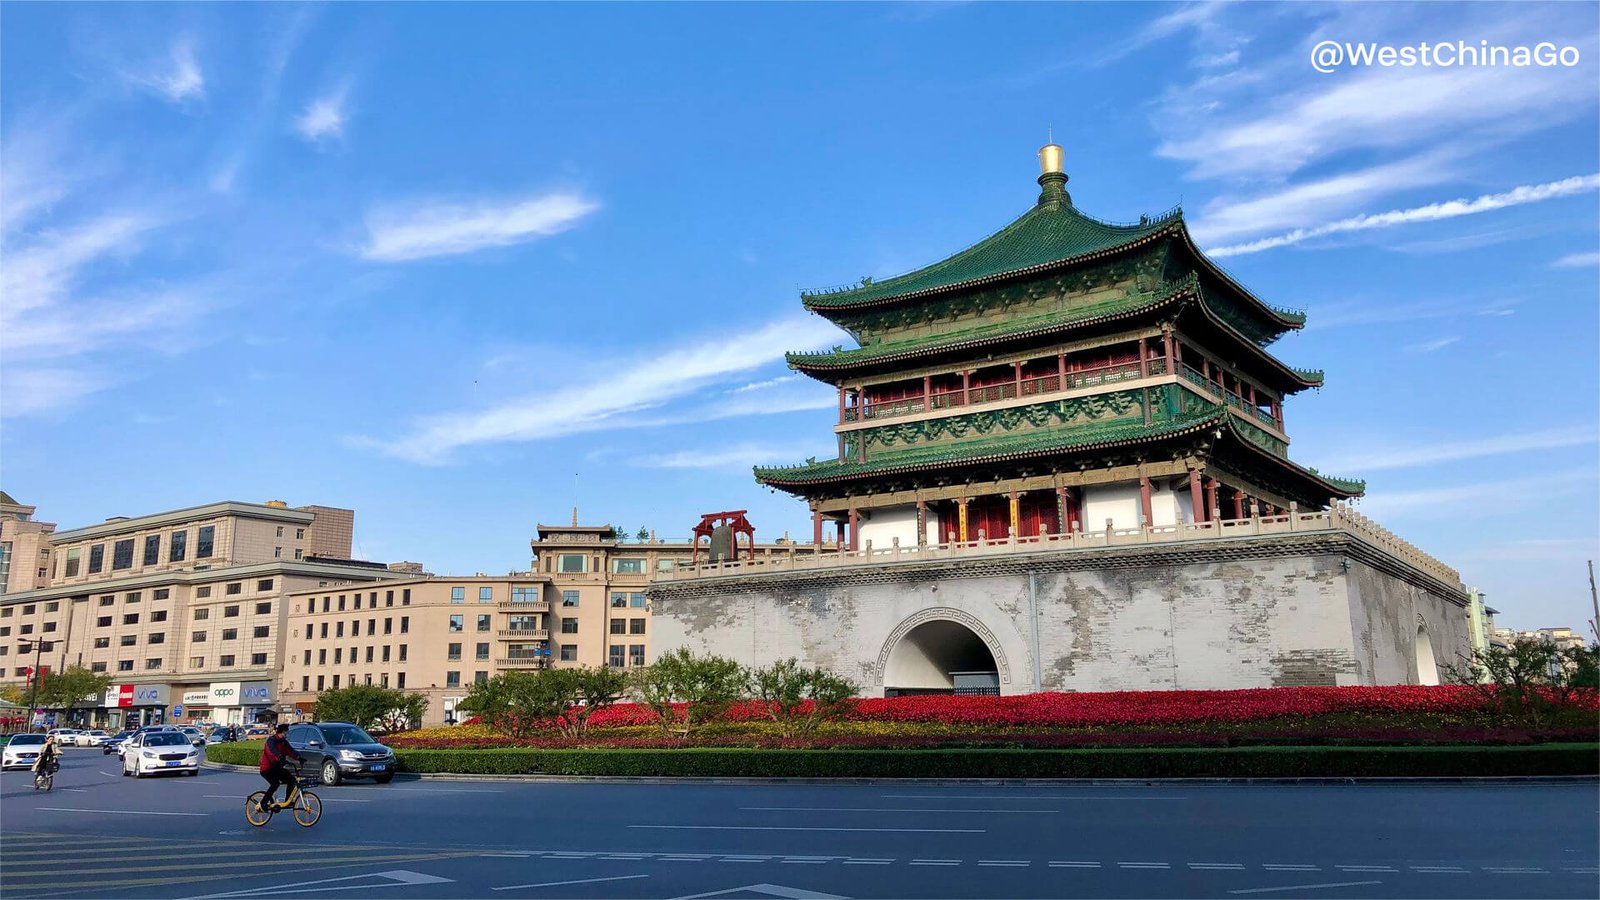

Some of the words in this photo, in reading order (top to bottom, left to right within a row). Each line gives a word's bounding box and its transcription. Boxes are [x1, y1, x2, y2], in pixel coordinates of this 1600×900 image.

[137, 688, 158, 699] vivo
[214, 688, 234, 698] oppo
[244, 686, 269, 698] vivo
